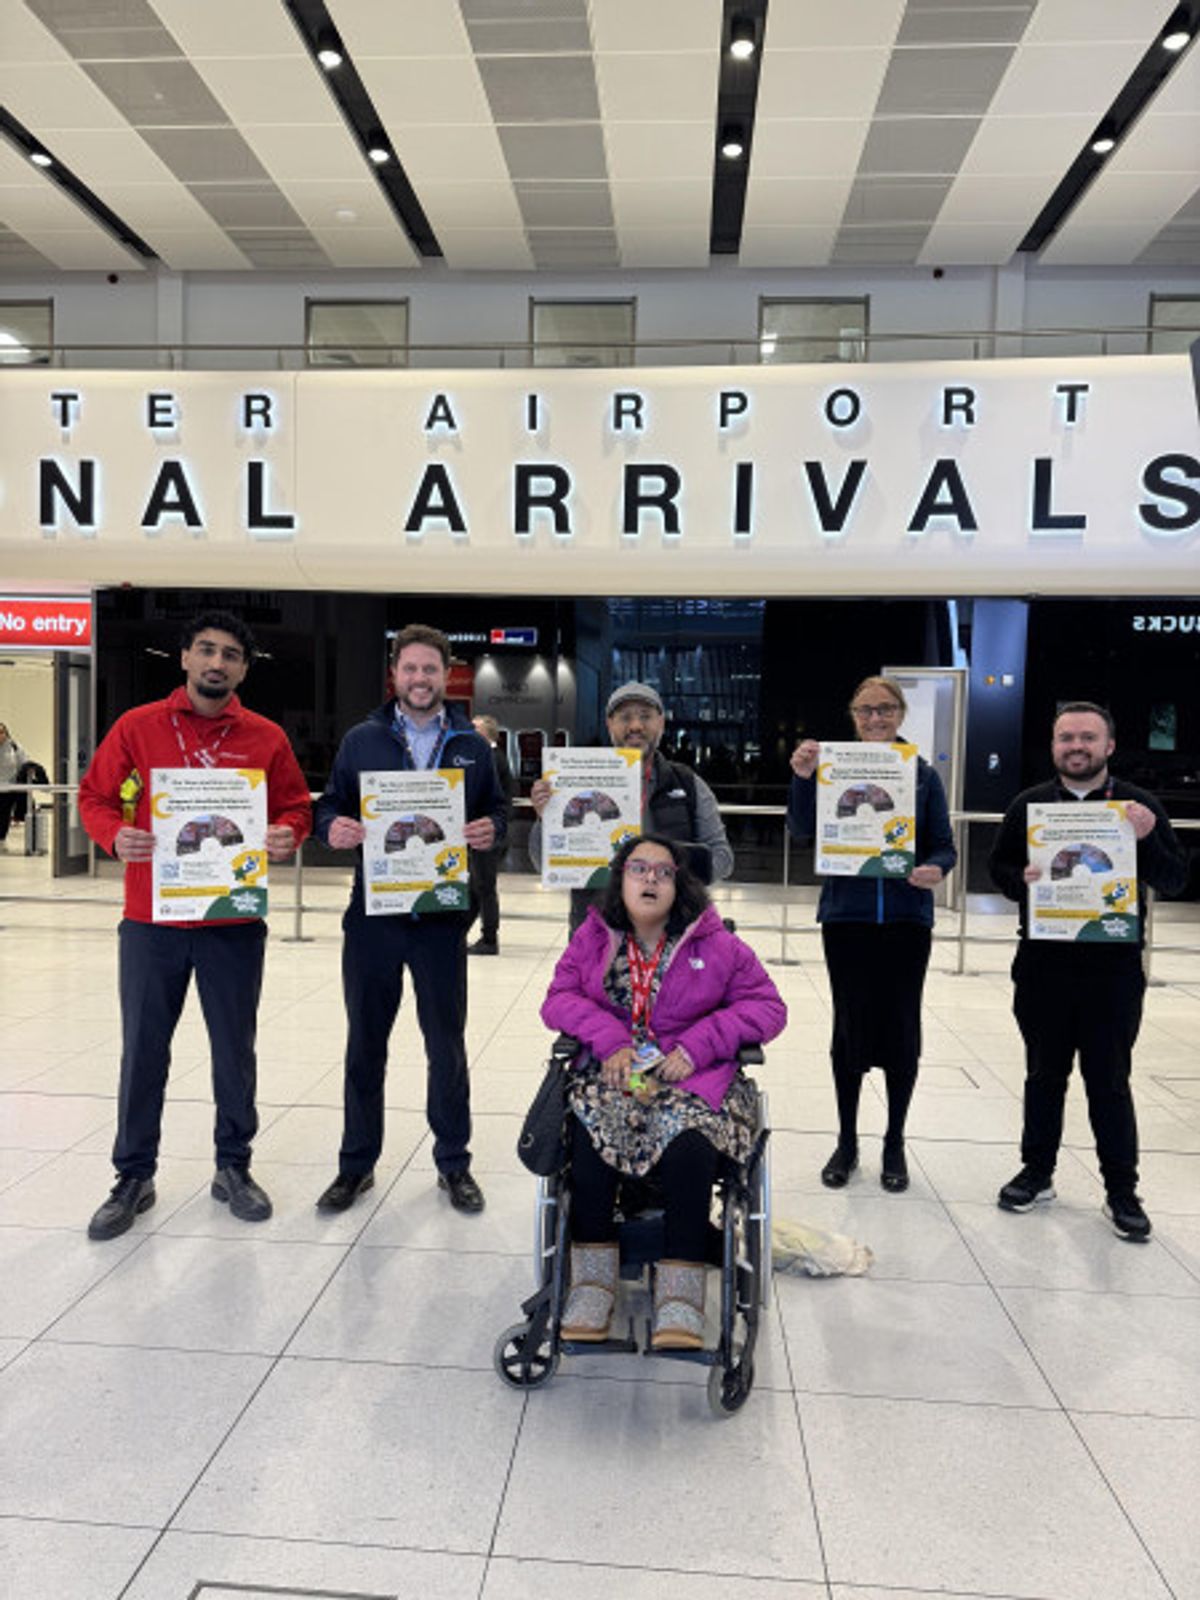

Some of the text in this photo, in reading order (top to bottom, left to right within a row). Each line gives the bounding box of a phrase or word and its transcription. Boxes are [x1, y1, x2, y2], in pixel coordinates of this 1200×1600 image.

[52, 384, 1089, 429] TER AIRPORT
[40, 454, 1200, 534] NAL ARRIVALS
[0, 611, 88, 637] No entry
